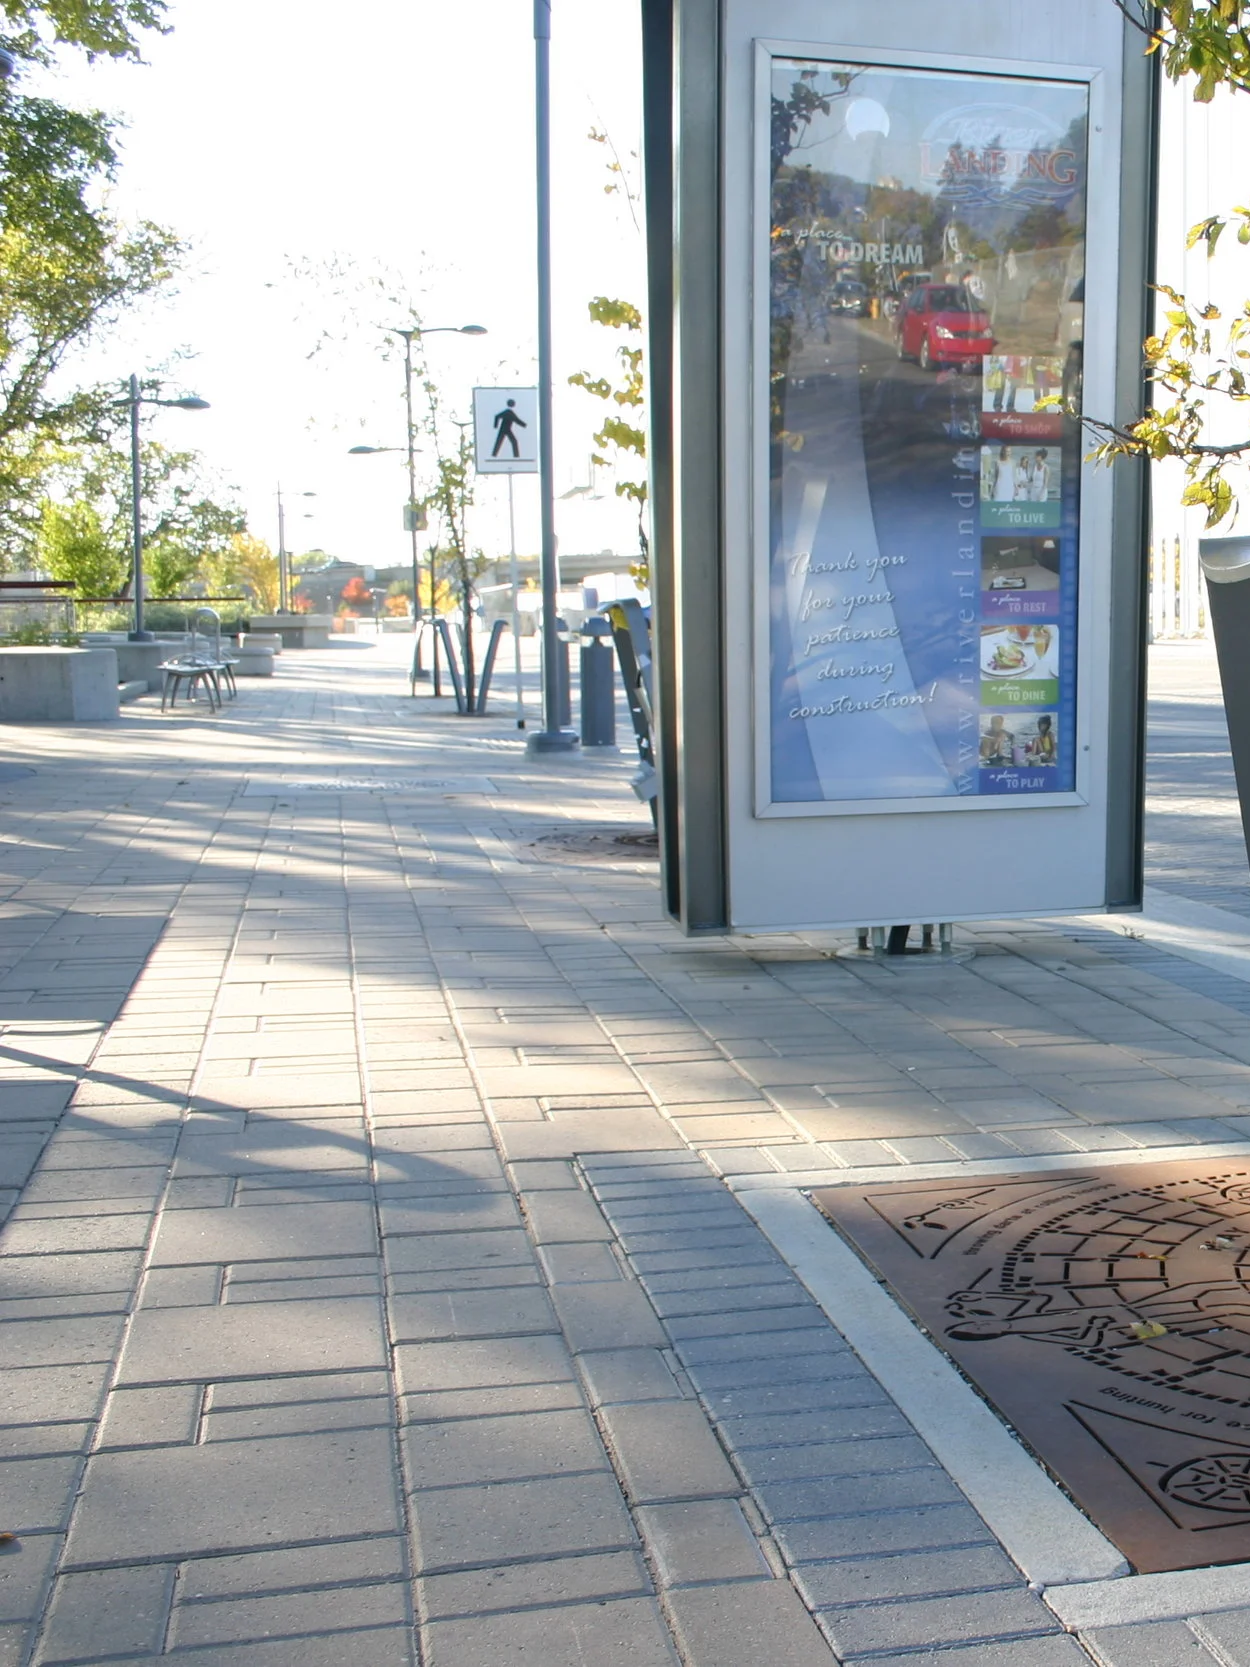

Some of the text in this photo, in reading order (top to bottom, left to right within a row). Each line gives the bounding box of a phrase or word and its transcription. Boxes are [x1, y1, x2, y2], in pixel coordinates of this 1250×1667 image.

[919, 142, 1077, 185] LANDING
[818, 240, 923, 264] TO DREAM
[1024, 513, 1045, 523] LIVE
[788, 552, 908, 583] Thank you
[801, 589, 895, 621] for your
[1023, 602, 1046, 612] REST
[804, 624, 900, 656] patience
[817, 658, 894, 682] during
[789, 681, 937, 719] construction!
[1021, 778, 1045, 788] PLAY
[1099, 1386, 1176, 1415] hunting
[1180, 1411, 1218, 1424] for
